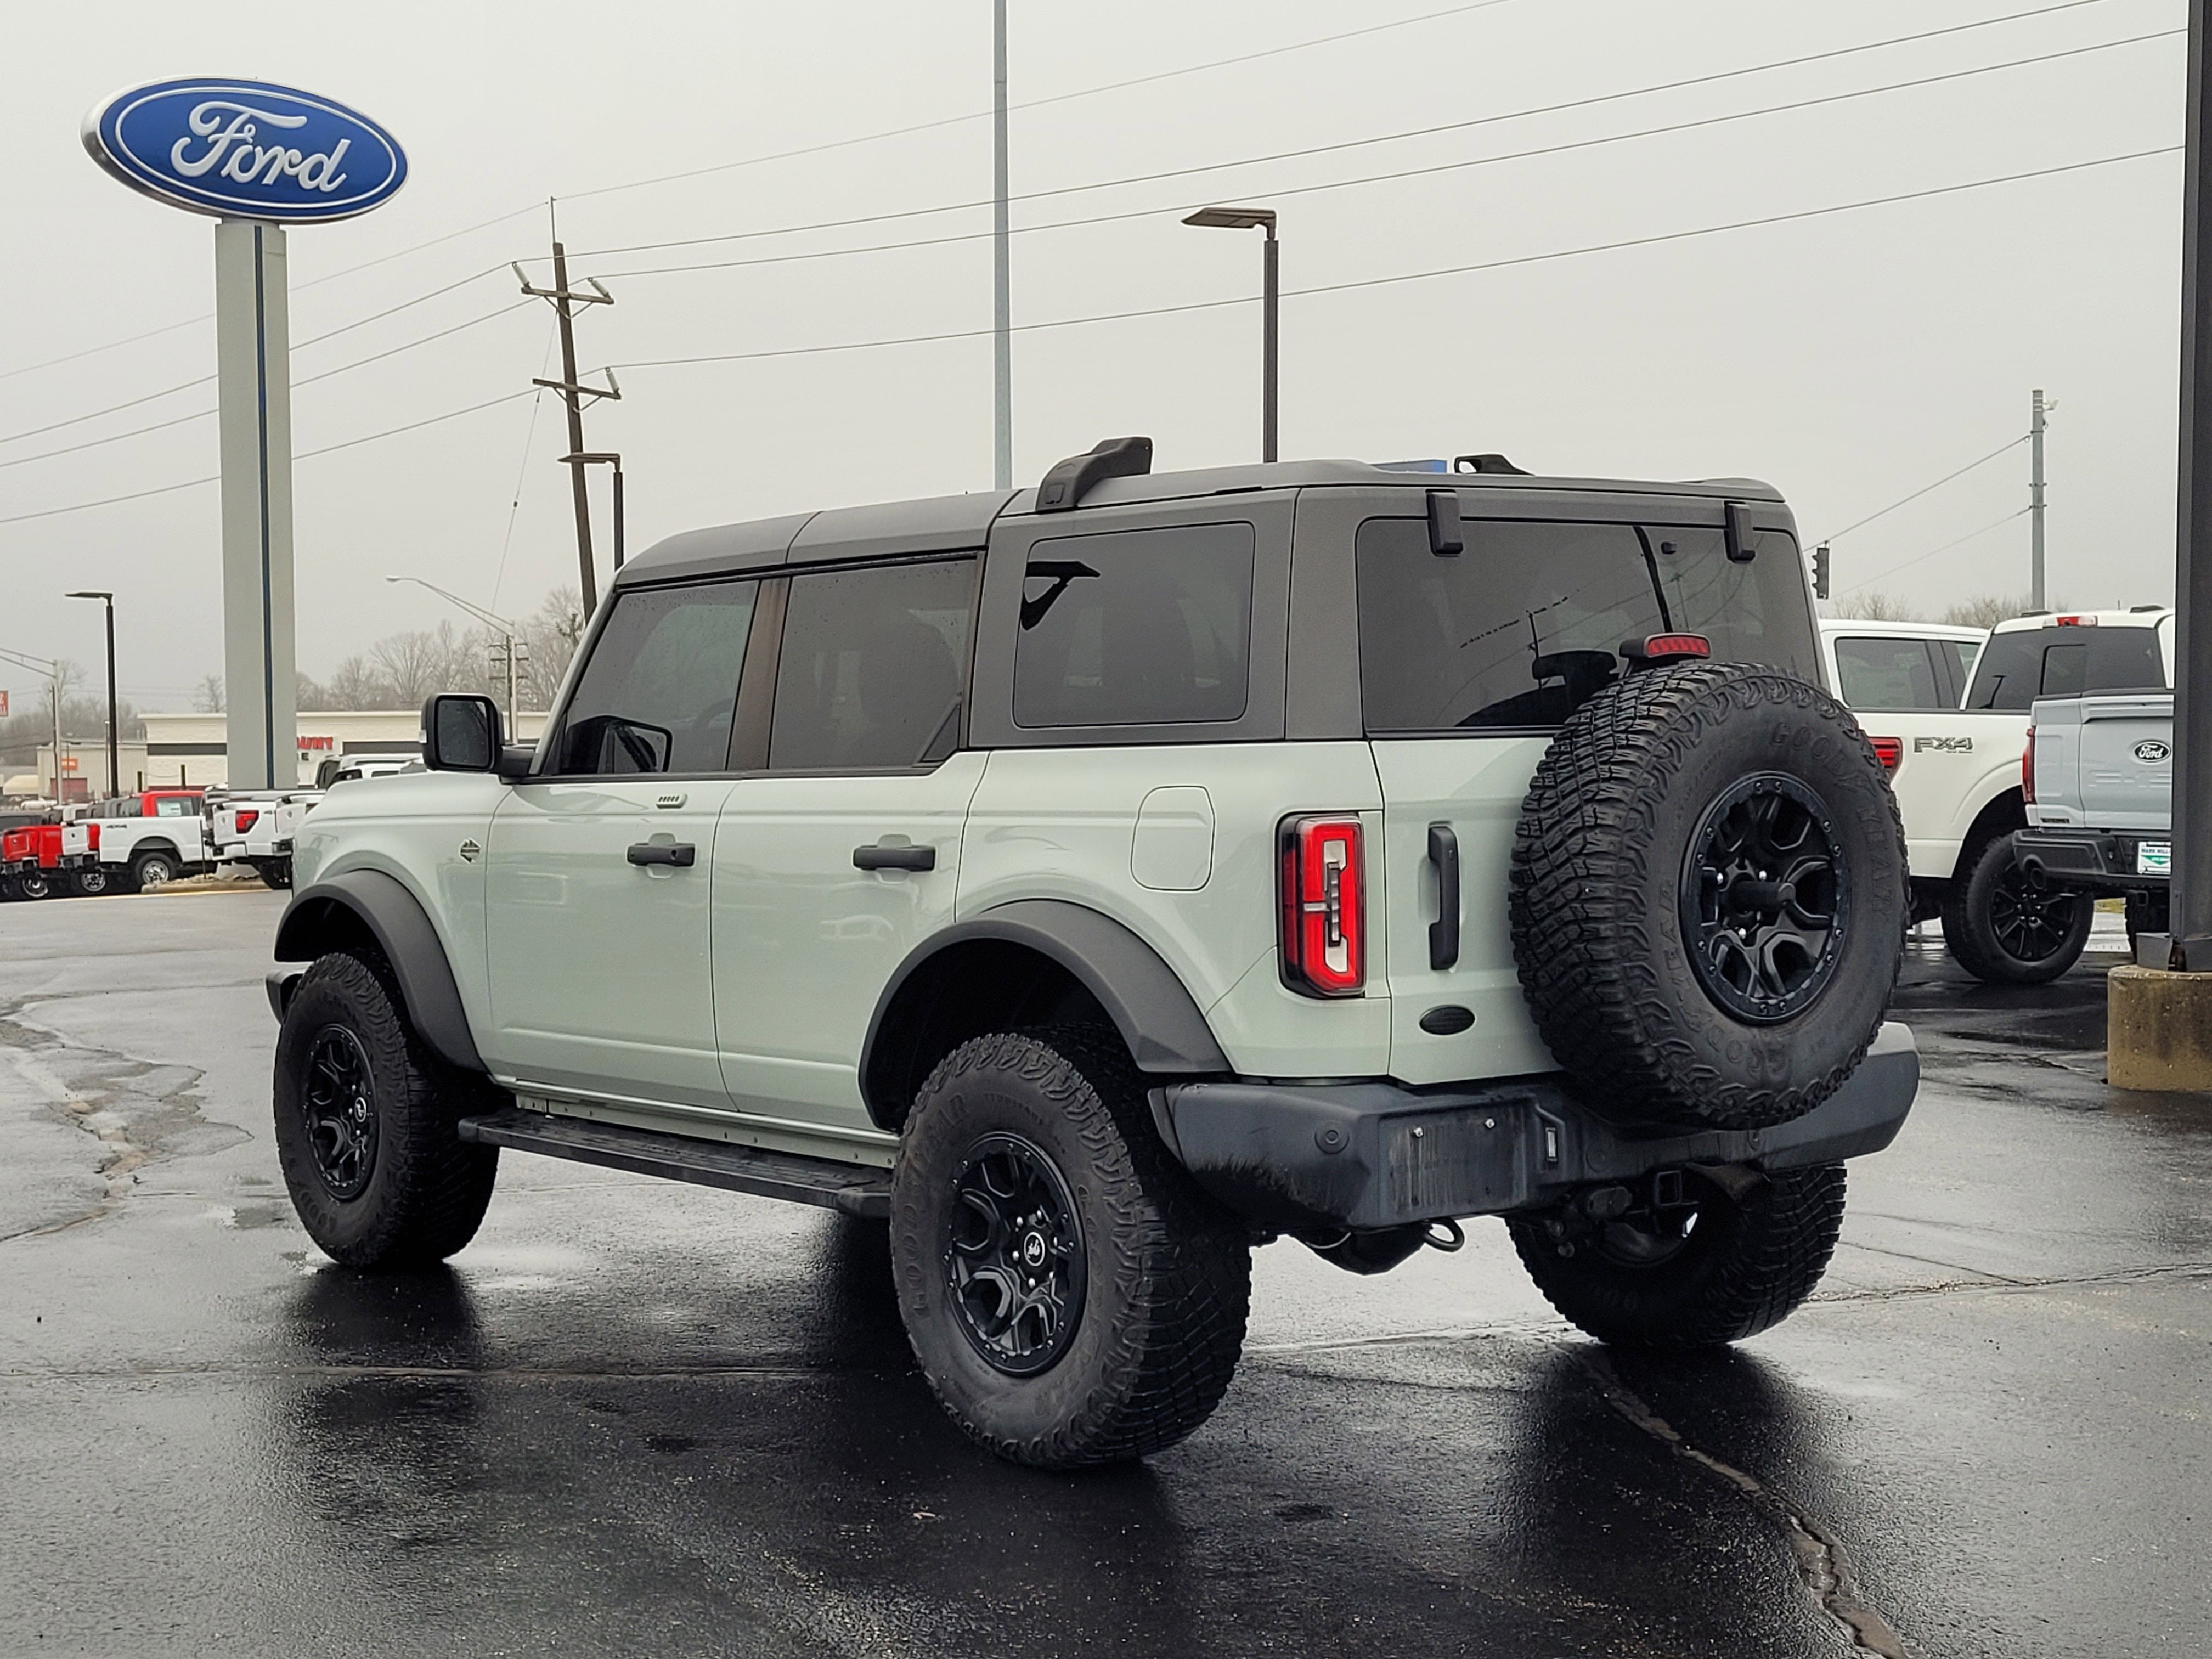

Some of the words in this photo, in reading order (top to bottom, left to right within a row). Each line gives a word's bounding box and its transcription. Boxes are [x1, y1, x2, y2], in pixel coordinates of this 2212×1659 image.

[170, 100, 352, 193] Ford
[297, 736, 333, 750] UNT
[1914, 737, 1973, 753] FX4
[2138, 744, 2164, 758] Ford
